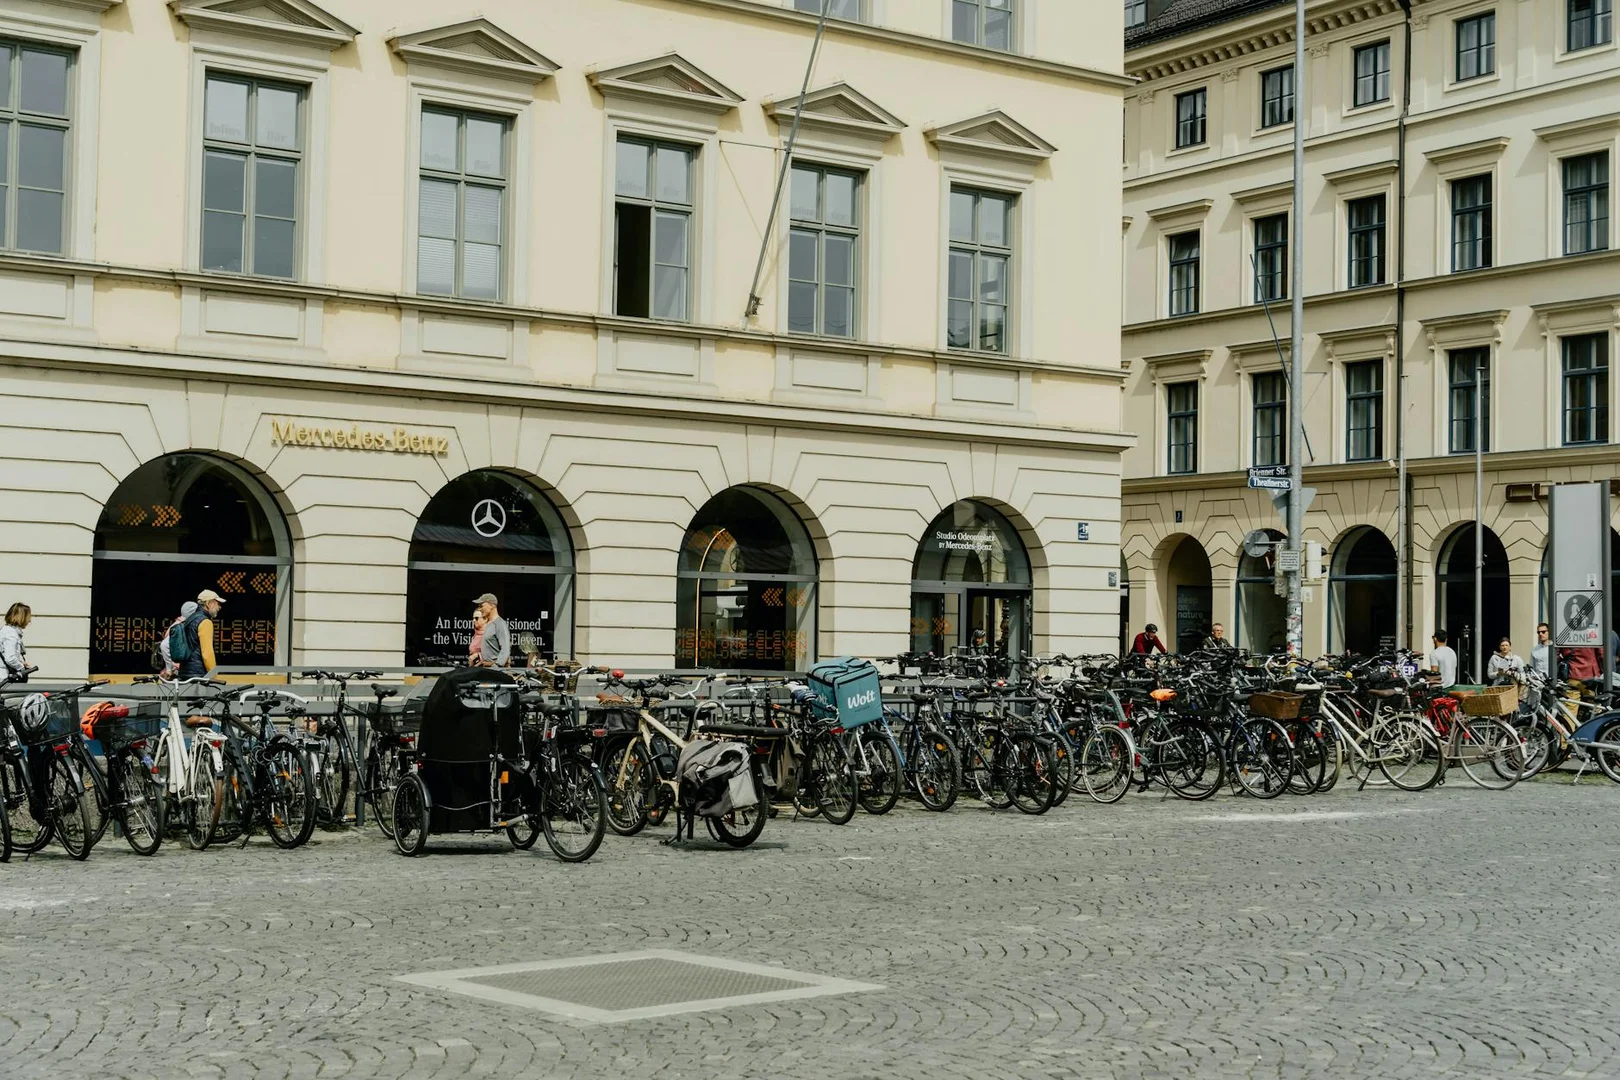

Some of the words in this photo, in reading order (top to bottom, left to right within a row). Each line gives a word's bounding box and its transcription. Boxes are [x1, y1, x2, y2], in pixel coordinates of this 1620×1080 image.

[271, 417, 449, 453] Mercedes-Benz
[1250, 468, 1275, 477] Brienner
[1276, 466, 1287, 476] Str.
[936, 531, 957, 540] Studio
[957, 533, 995, 543] Odeonsplatz
[945, 540, 993, 551] Mercedes-Benz
[1178, 609, 1204, 619] nature
[96, 617, 156, 628] VISION
[435, 616, 451, 629] An
[507, 618, 541, 630] isioned
[96, 628, 156, 640] VISION
[433, 632, 449, 645] the
[451, 632, 472, 645] Visi
[95, 640, 155, 652] VISION
[847, 690, 876, 709] Wolt
